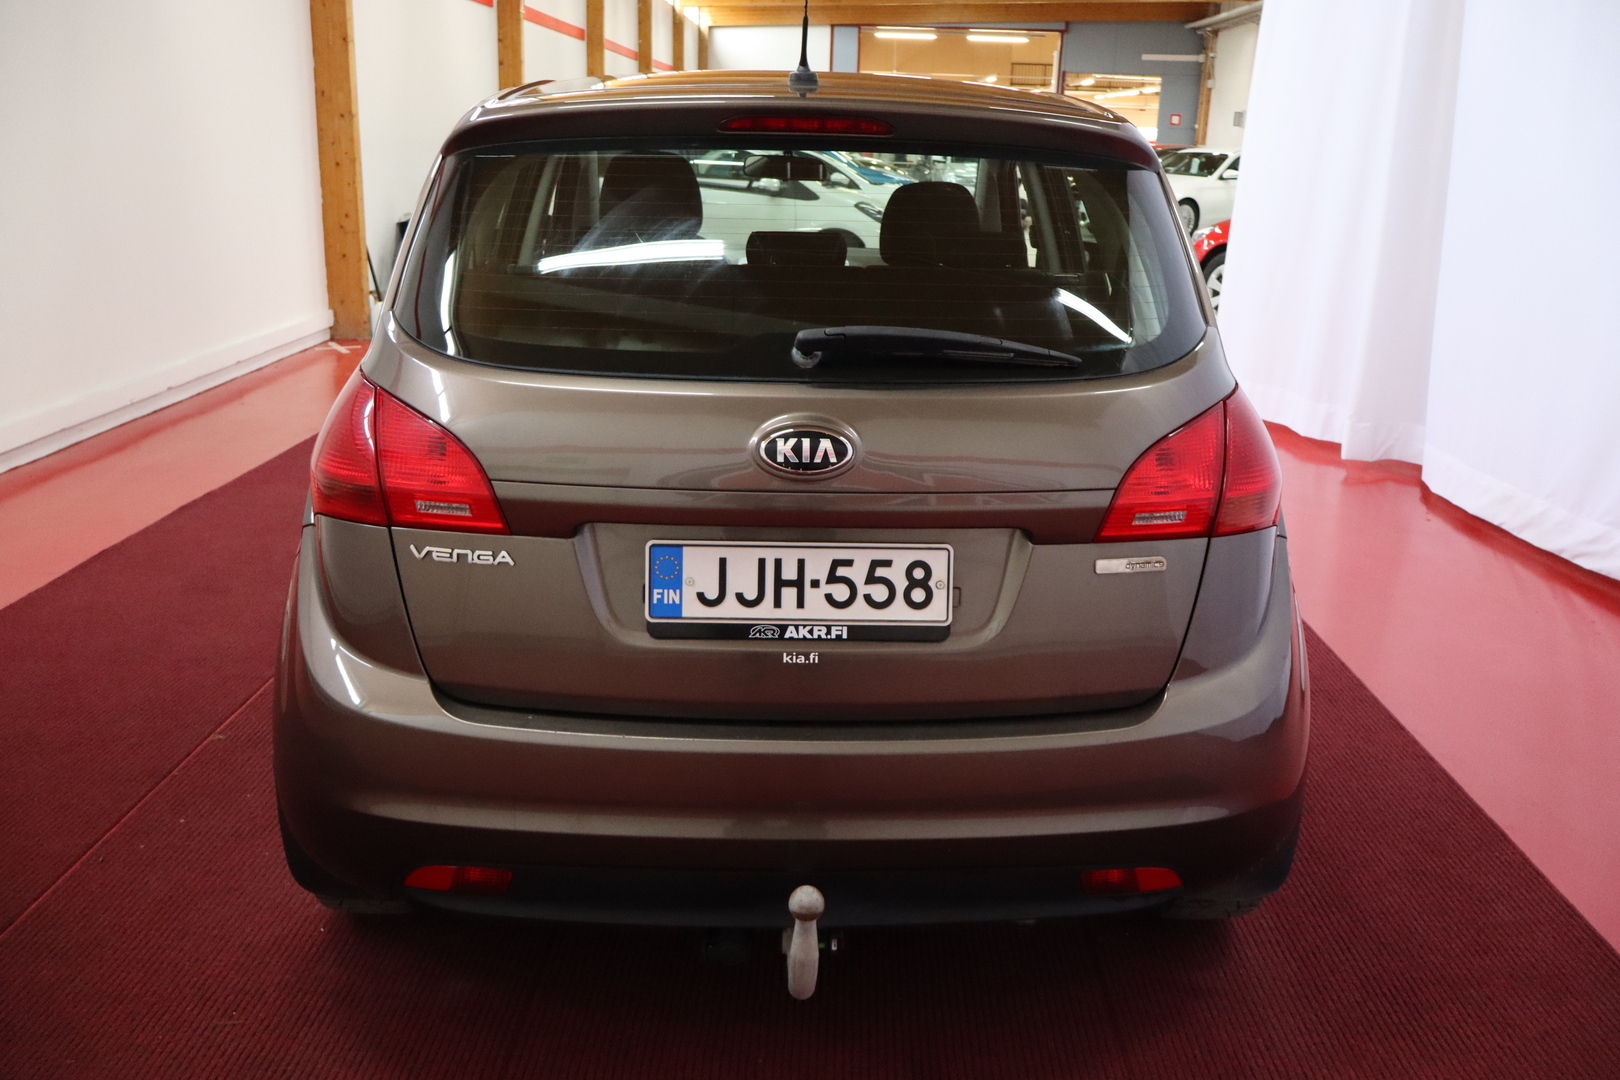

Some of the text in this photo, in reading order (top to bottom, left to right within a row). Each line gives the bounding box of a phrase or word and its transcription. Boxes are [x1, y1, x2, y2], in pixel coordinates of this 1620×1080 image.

[776, 438, 837, 463] KIA
[409, 544, 515, 566] VENGA
[696, 557, 934, 610] JJH-558
[653, 589, 680, 605] FIN
[784, 625, 848, 639] AKR.FI
[783, 652, 819, 664] kia.fi
